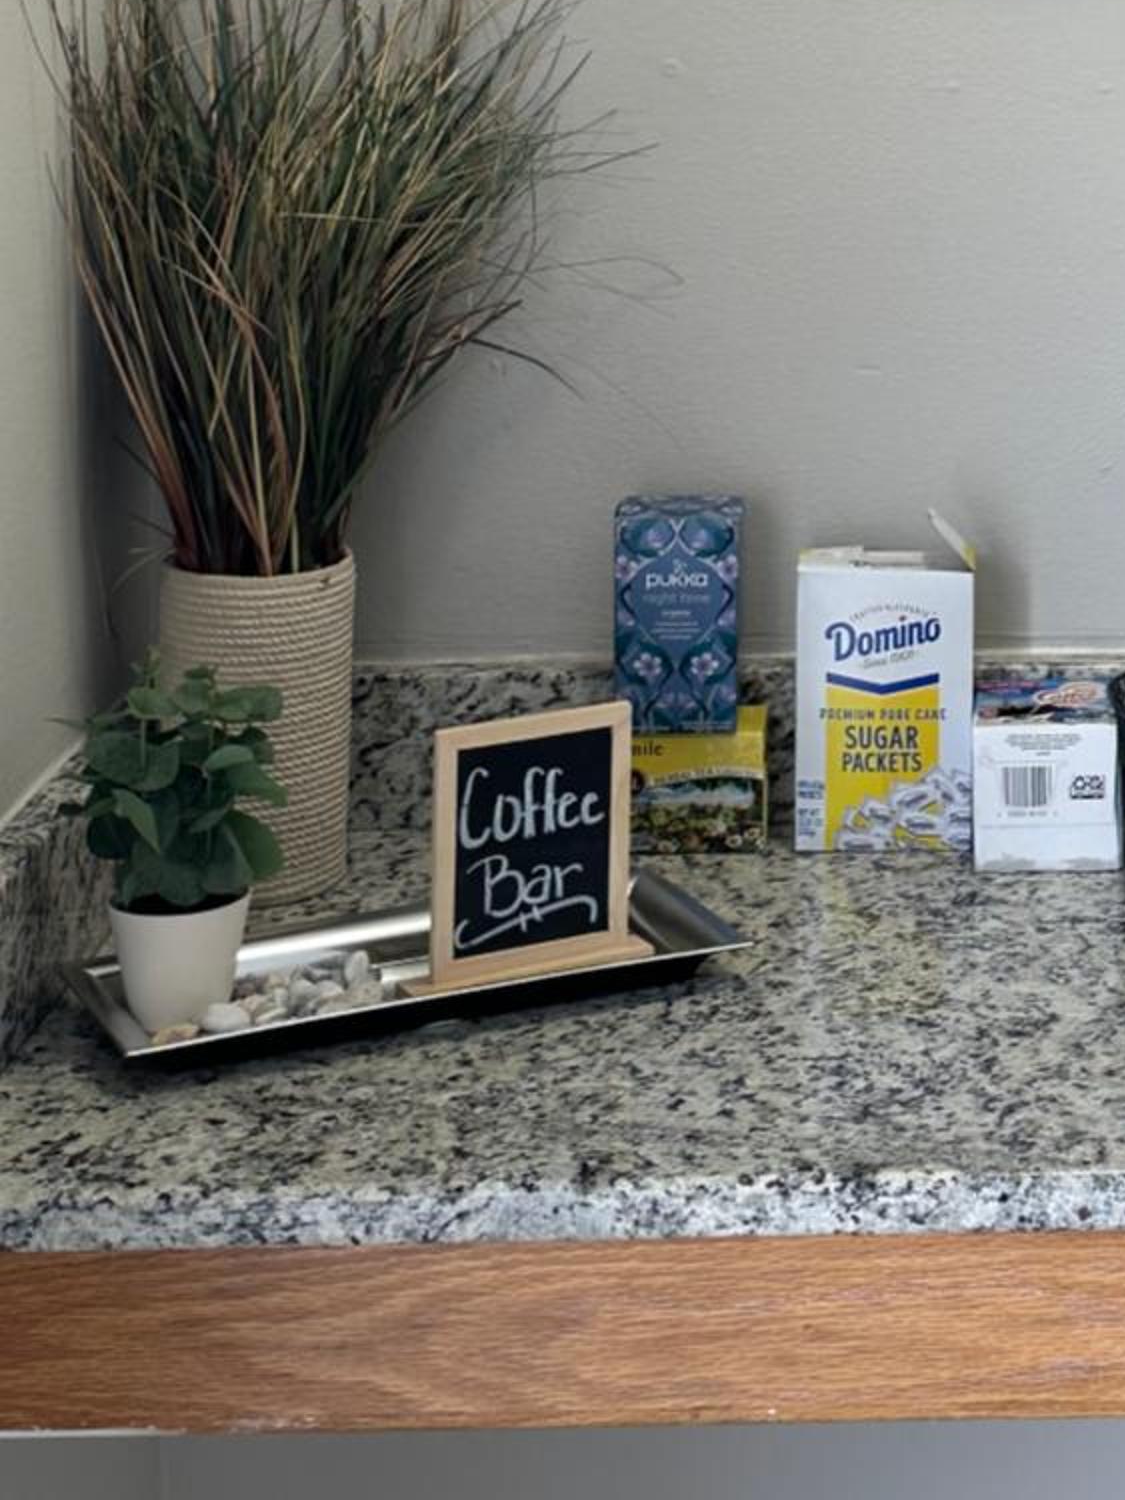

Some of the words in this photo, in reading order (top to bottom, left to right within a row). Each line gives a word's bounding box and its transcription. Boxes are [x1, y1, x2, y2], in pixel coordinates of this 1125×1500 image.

[644, 572, 709, 591] pukka
[824, 615, 942, 663] Domino
[844, 725, 919, 749] SUGAR
[841, 751, 923, 773] PACKETS
[458, 765, 606, 849] Coffee
[465, 853, 584, 919] Bar
